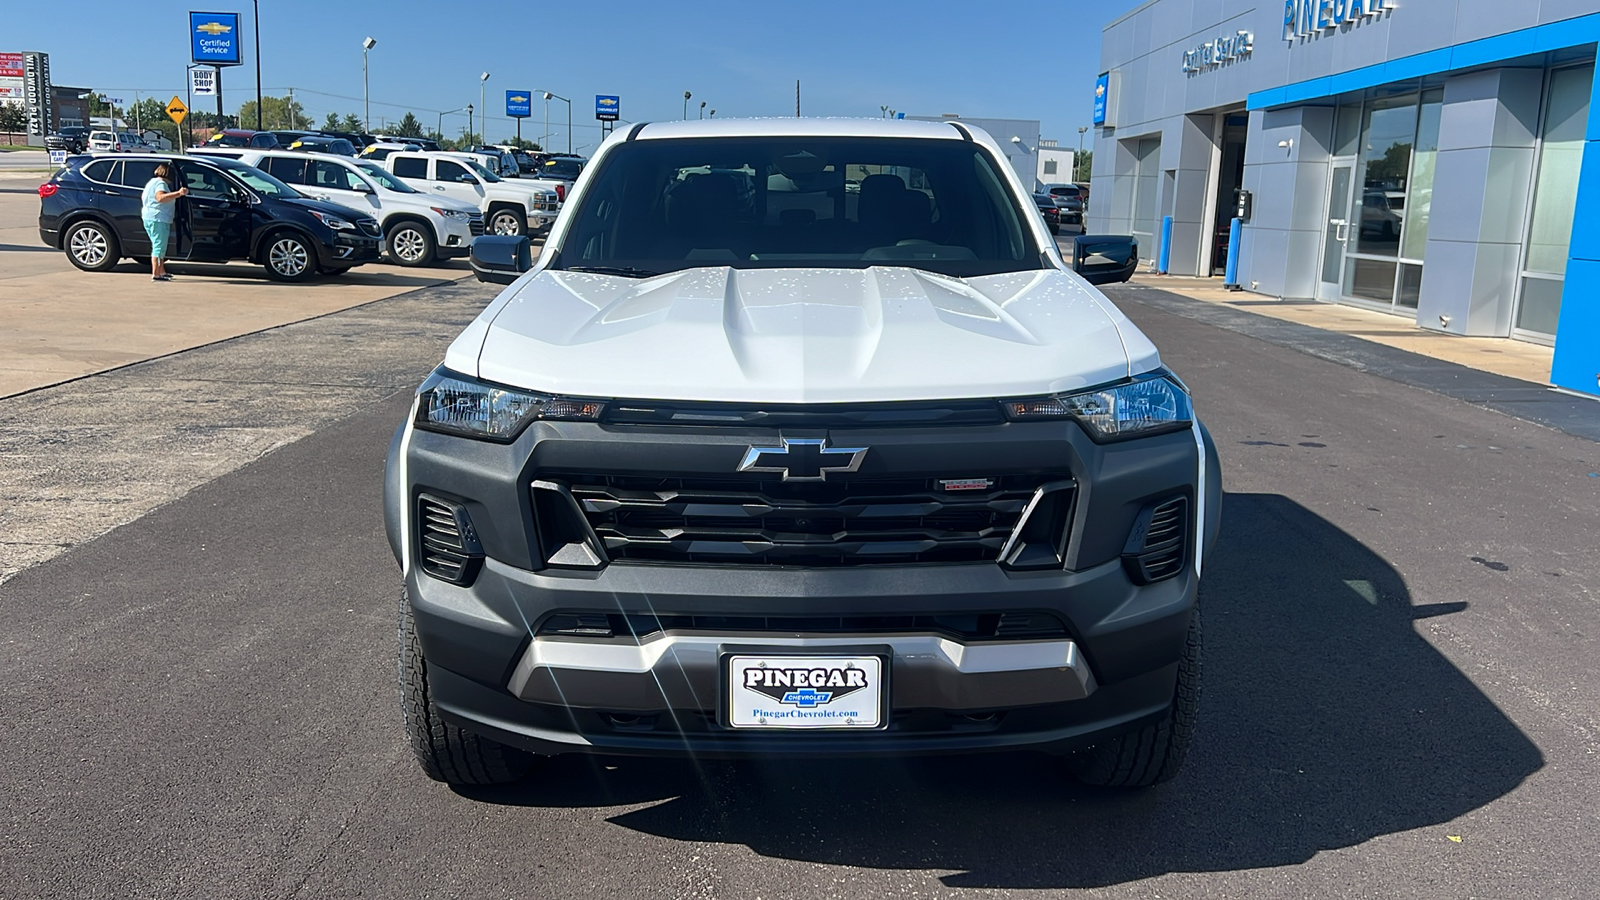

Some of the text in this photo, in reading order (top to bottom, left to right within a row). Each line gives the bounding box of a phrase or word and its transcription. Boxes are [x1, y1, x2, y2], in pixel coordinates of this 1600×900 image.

[1281, 0, 1397, 41] PINEGA
[199, 39, 230, 47] Certified
[202, 46, 228, 54] Service
[194, 71, 213, 79] BODY
[43, 56, 51, 105] WILDWOOD
[194, 79, 213, 87] SHOP
[25, 54, 38, 134] WILDWOOD PLAZA
[744, 668, 868, 688] PINEGAR
[752, 708, 858, 718] PinegarChevrolet.com
